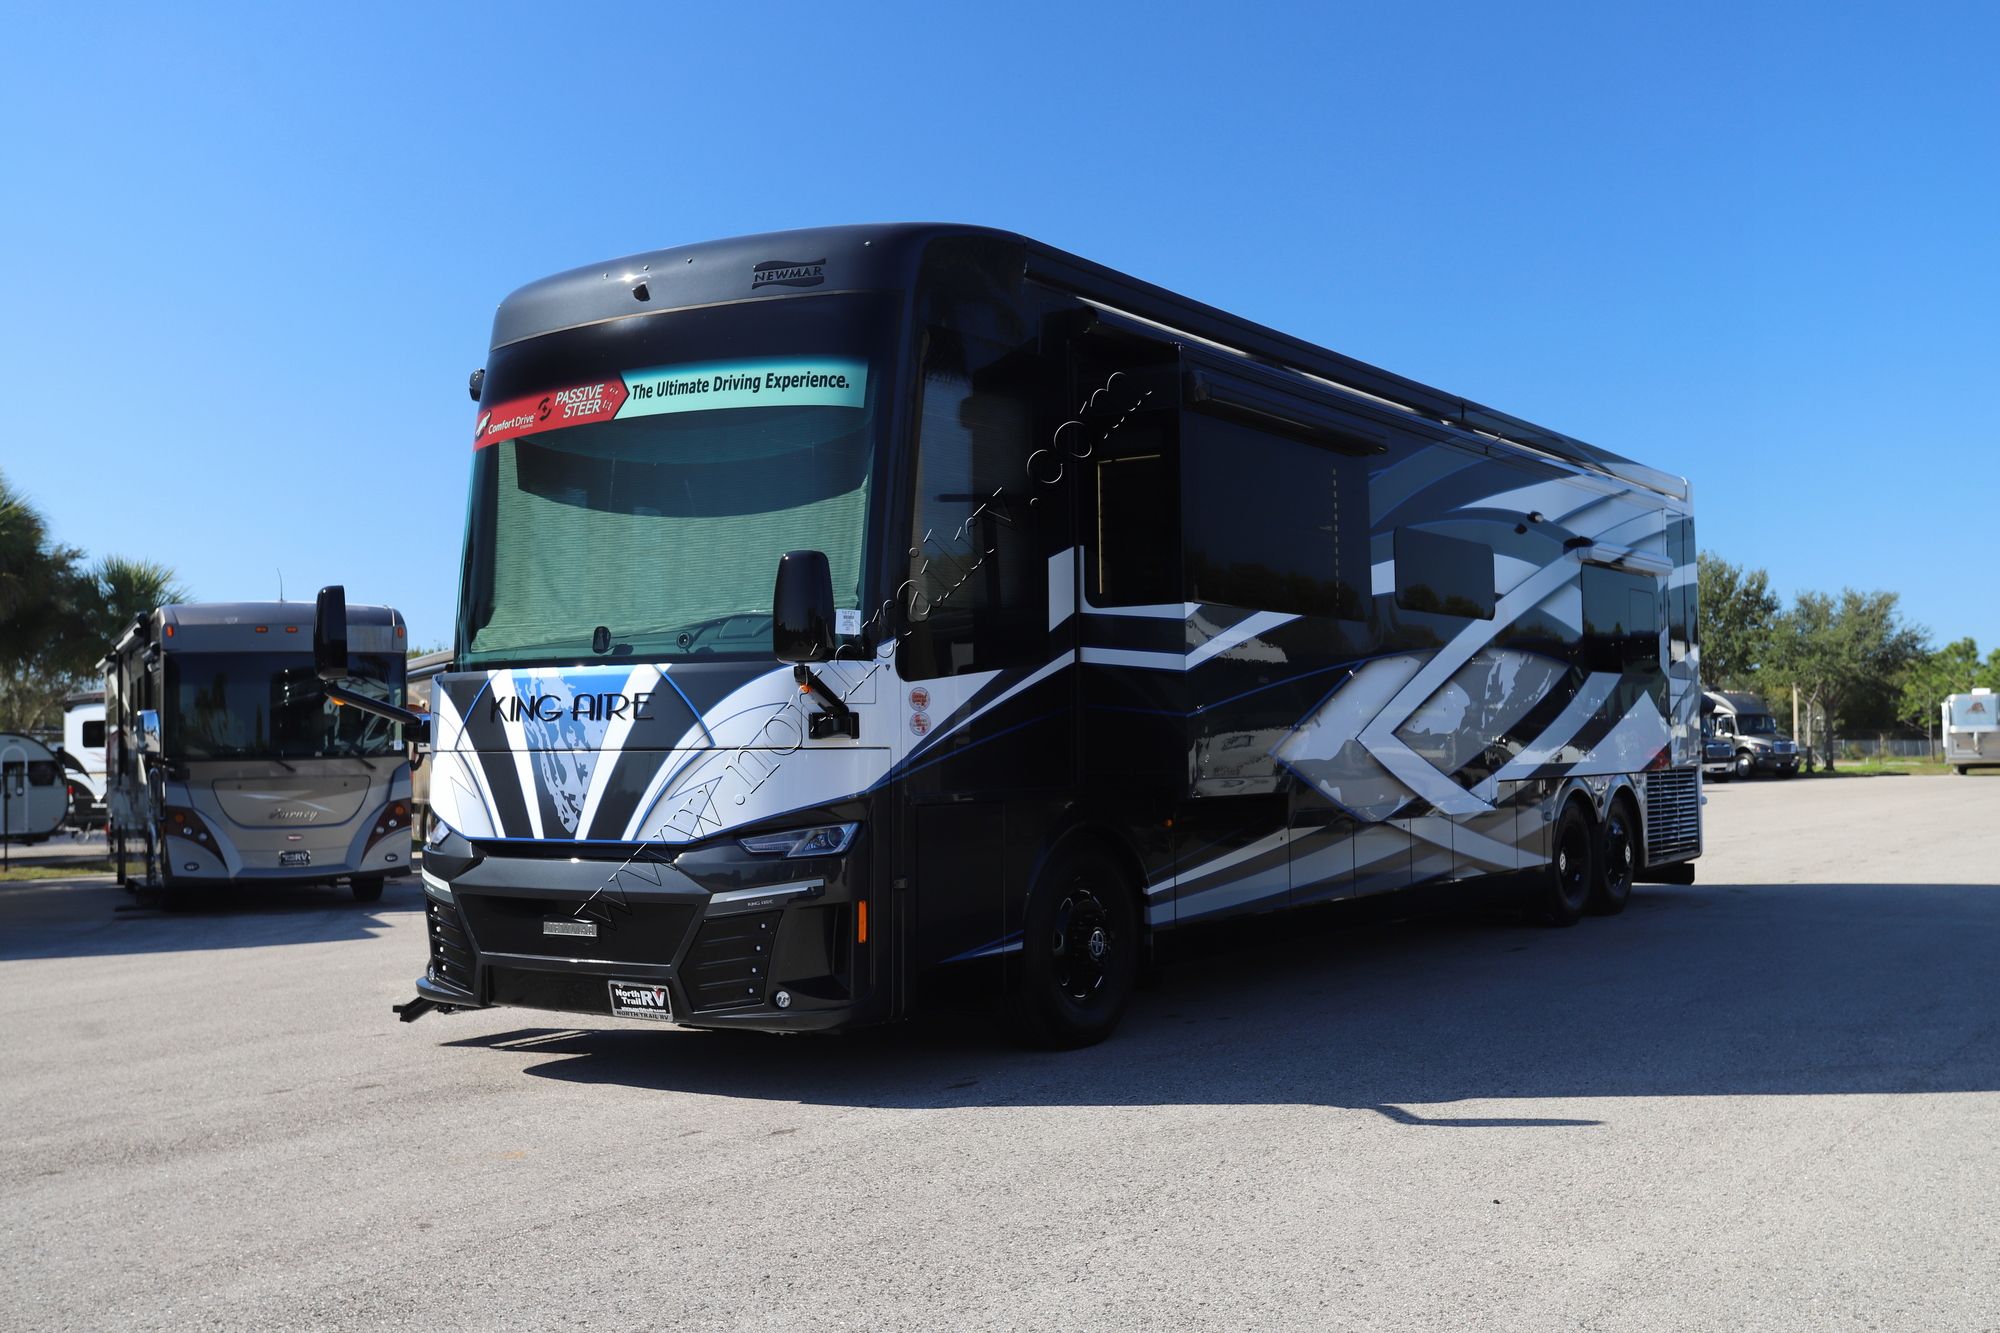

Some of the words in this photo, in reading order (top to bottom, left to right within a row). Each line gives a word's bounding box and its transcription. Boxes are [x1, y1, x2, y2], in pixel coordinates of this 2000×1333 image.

[754, 266, 824, 282] NEWMAR
[632, 384, 653, 400] The
[656, 377, 709, 397] Ultimate
[713, 373, 761, 393] Driving
[765, 371, 850, 392] Experience.
[555, 384, 604, 406] PASSIVE
[563, 400, 601, 418] STEER
[488, 418, 515, 434] Comfort
[515, 414, 535, 427] Drive
[490, 694, 563, 723] KING
[570, 692, 656, 721] AIRE
[615, 988, 640, 998] North
[621, 997, 641, 1006] Trail
[640, 990, 665, 1007] RV
